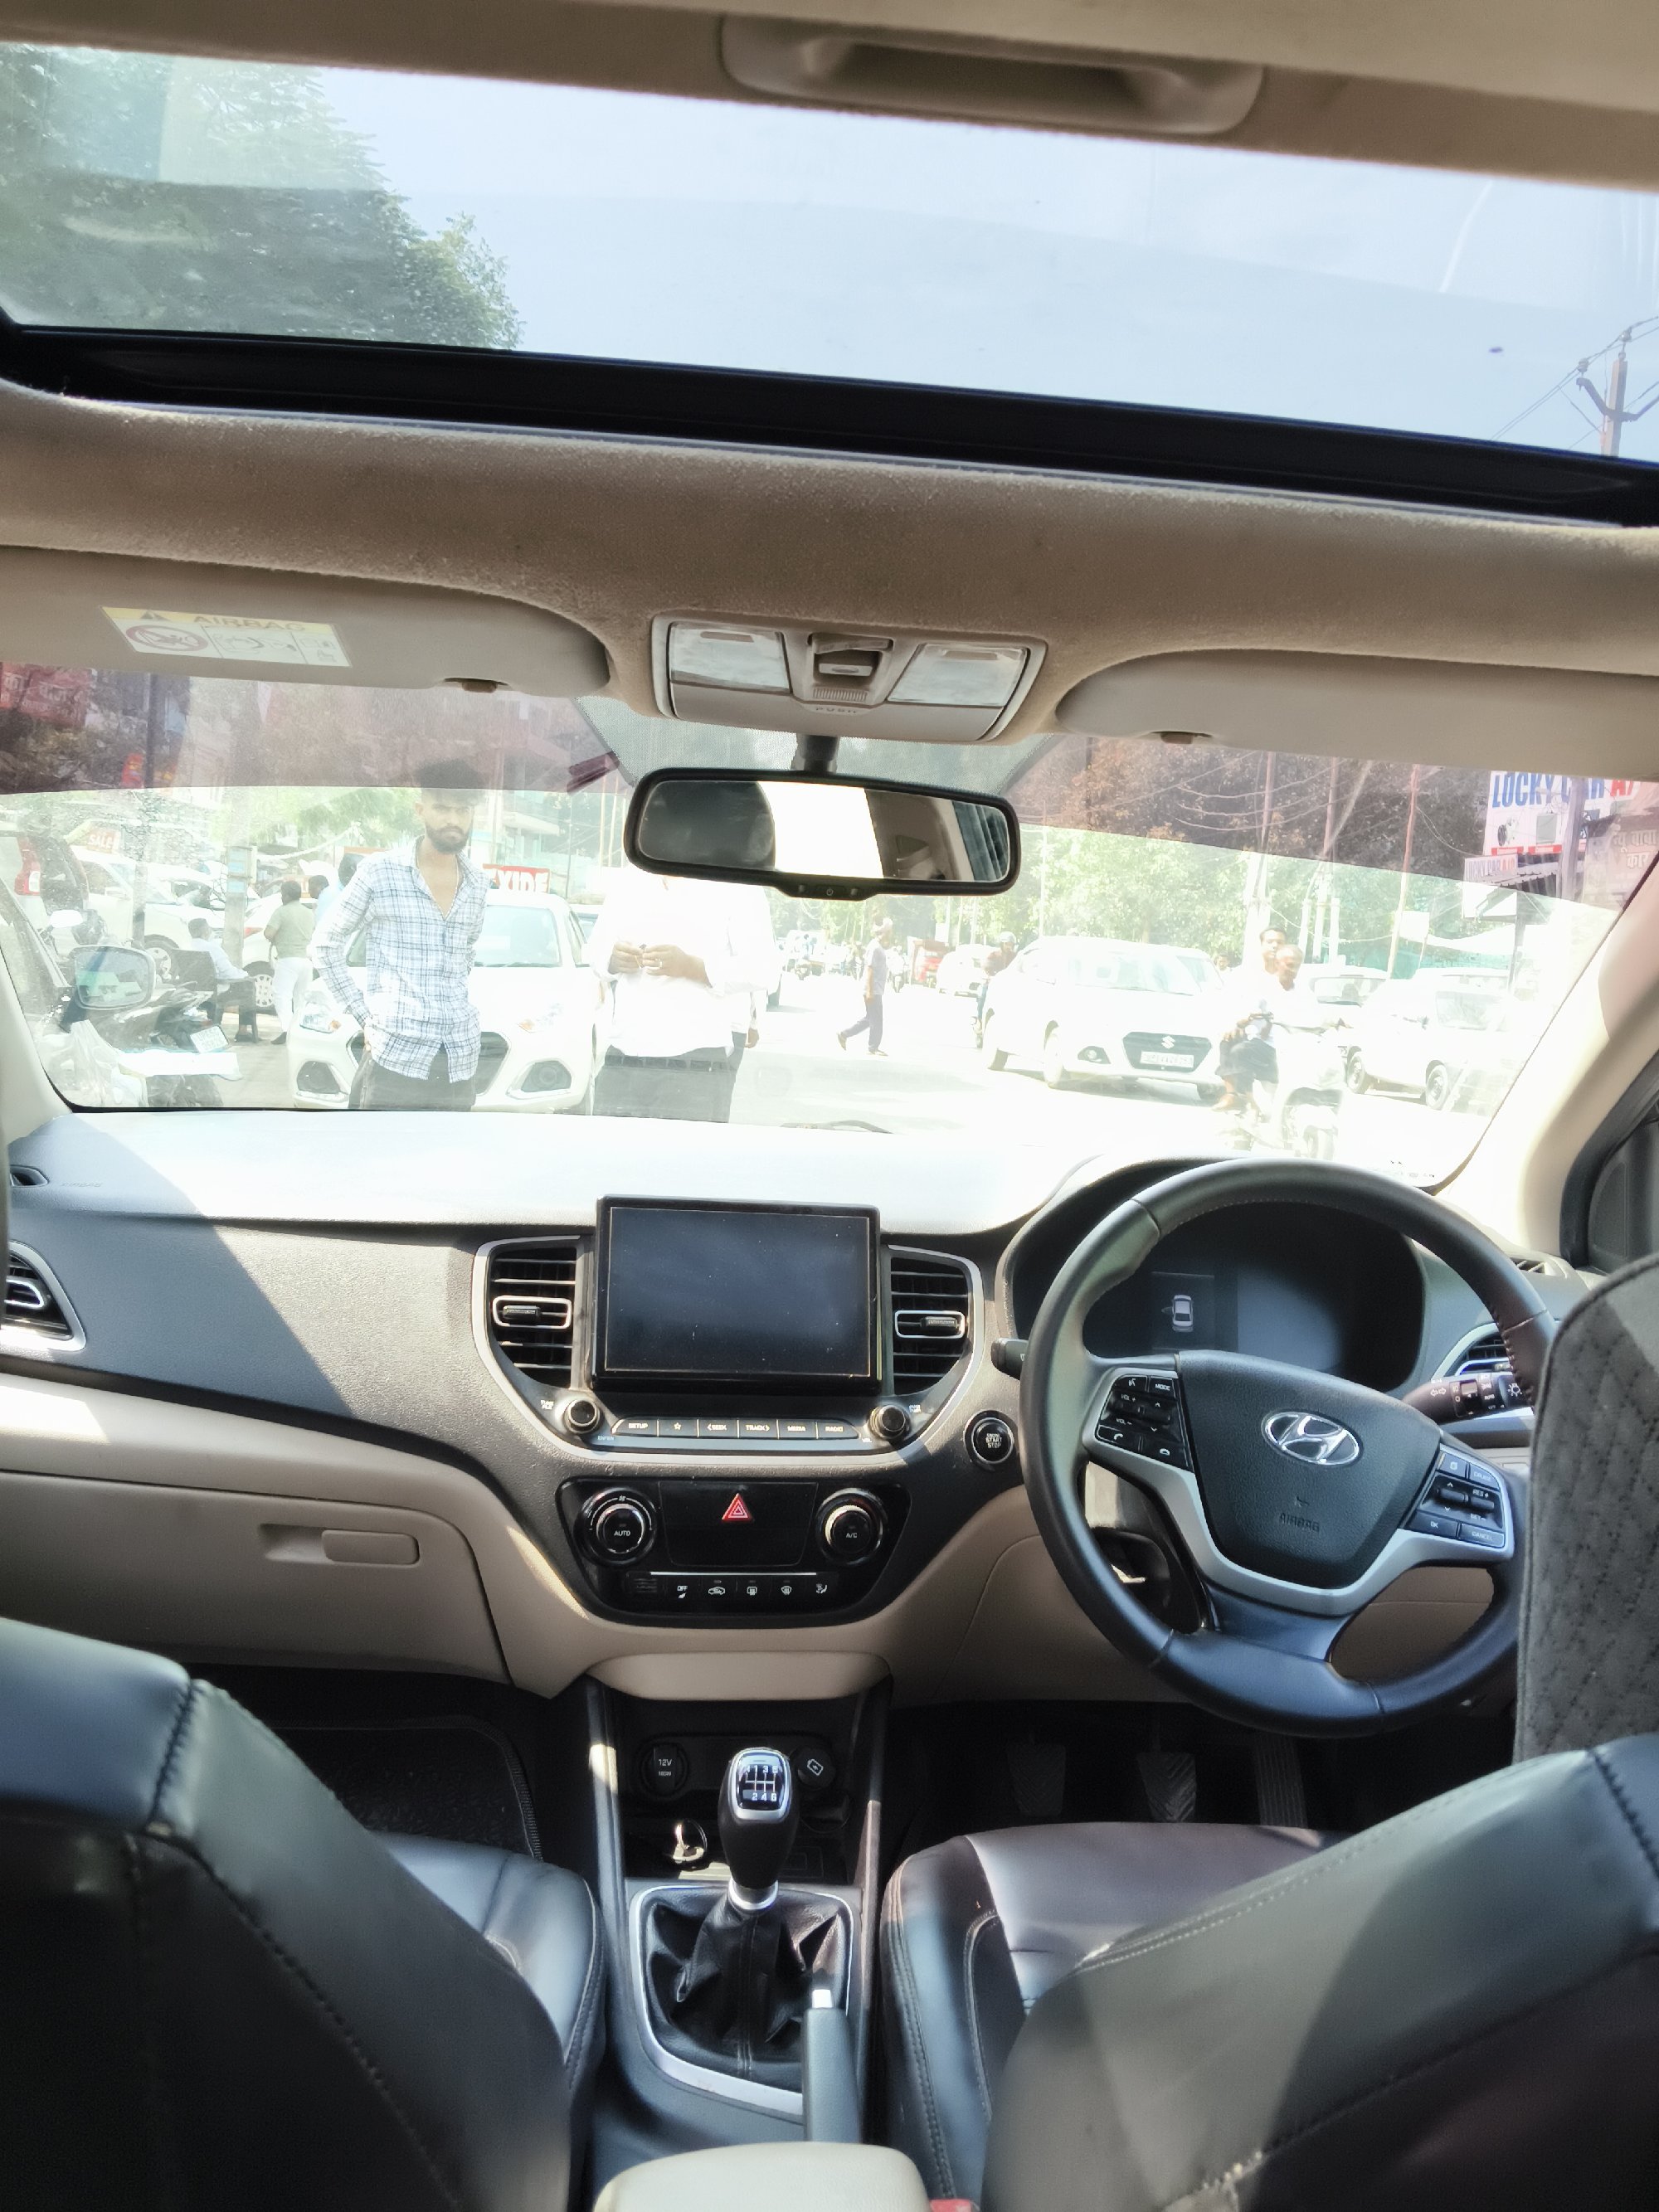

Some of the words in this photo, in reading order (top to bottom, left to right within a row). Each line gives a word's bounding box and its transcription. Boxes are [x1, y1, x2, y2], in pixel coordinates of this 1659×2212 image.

[193, 615, 305, 632] AIRBAG
[1280, 1512, 1320, 1533] AIRBAG
[1472, 1531, 1493, 1540] CANCEL
[771, 1793, 777, 1801] 6
